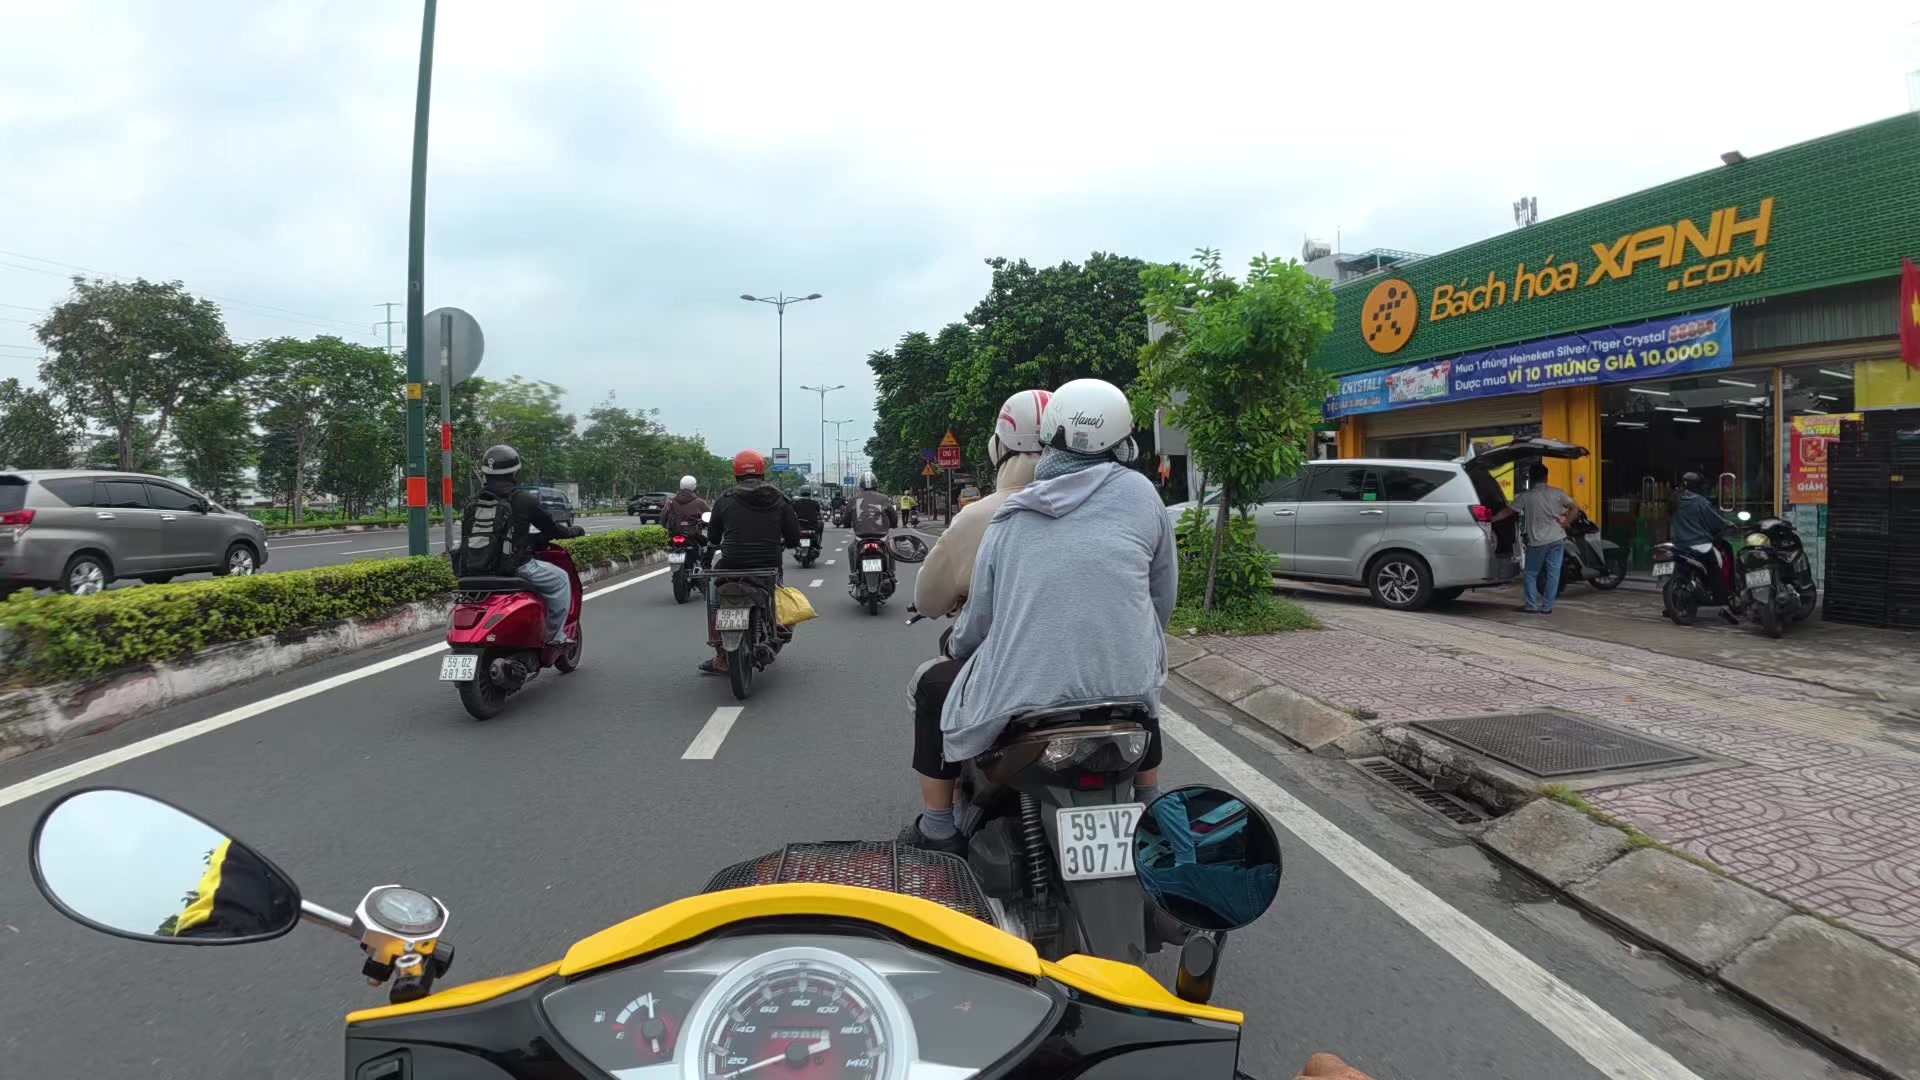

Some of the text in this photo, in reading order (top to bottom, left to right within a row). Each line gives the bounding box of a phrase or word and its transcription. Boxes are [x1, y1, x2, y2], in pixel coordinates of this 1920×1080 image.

[1430, 197, 1775, 322] Bách hóa XANH
[1455, 363, 1474, 374] Mua
[1482, 357, 1508, 369] thùng
[1509, 350, 1555, 365] Heineken
[1623, 330, 1666, 347] Crystal
[1483, 375, 1506, 386] mua
[1525, 366, 1541, 381] 10
[1544, 358, 1601, 379] TRỨNG
[1604, 349, 1636, 371] GIÁ
[1067, 411, 1104, 429] Hanoi
[1070, 810, 1133, 842] 59-V2
[1066, 841, 1129, 875] 307.7
[791, 999, 811, 1007] 80
[760, 1006, 779, 1014] 60
[816, 1006, 840, 1014] 100
[735, 1025, 756, 1033] 40
[840, 1025, 864, 1034] 120
[615, 1031, 625, 1040] E
[727, 1057, 748, 1065] 20
[845, 1058, 870, 1068] 140
